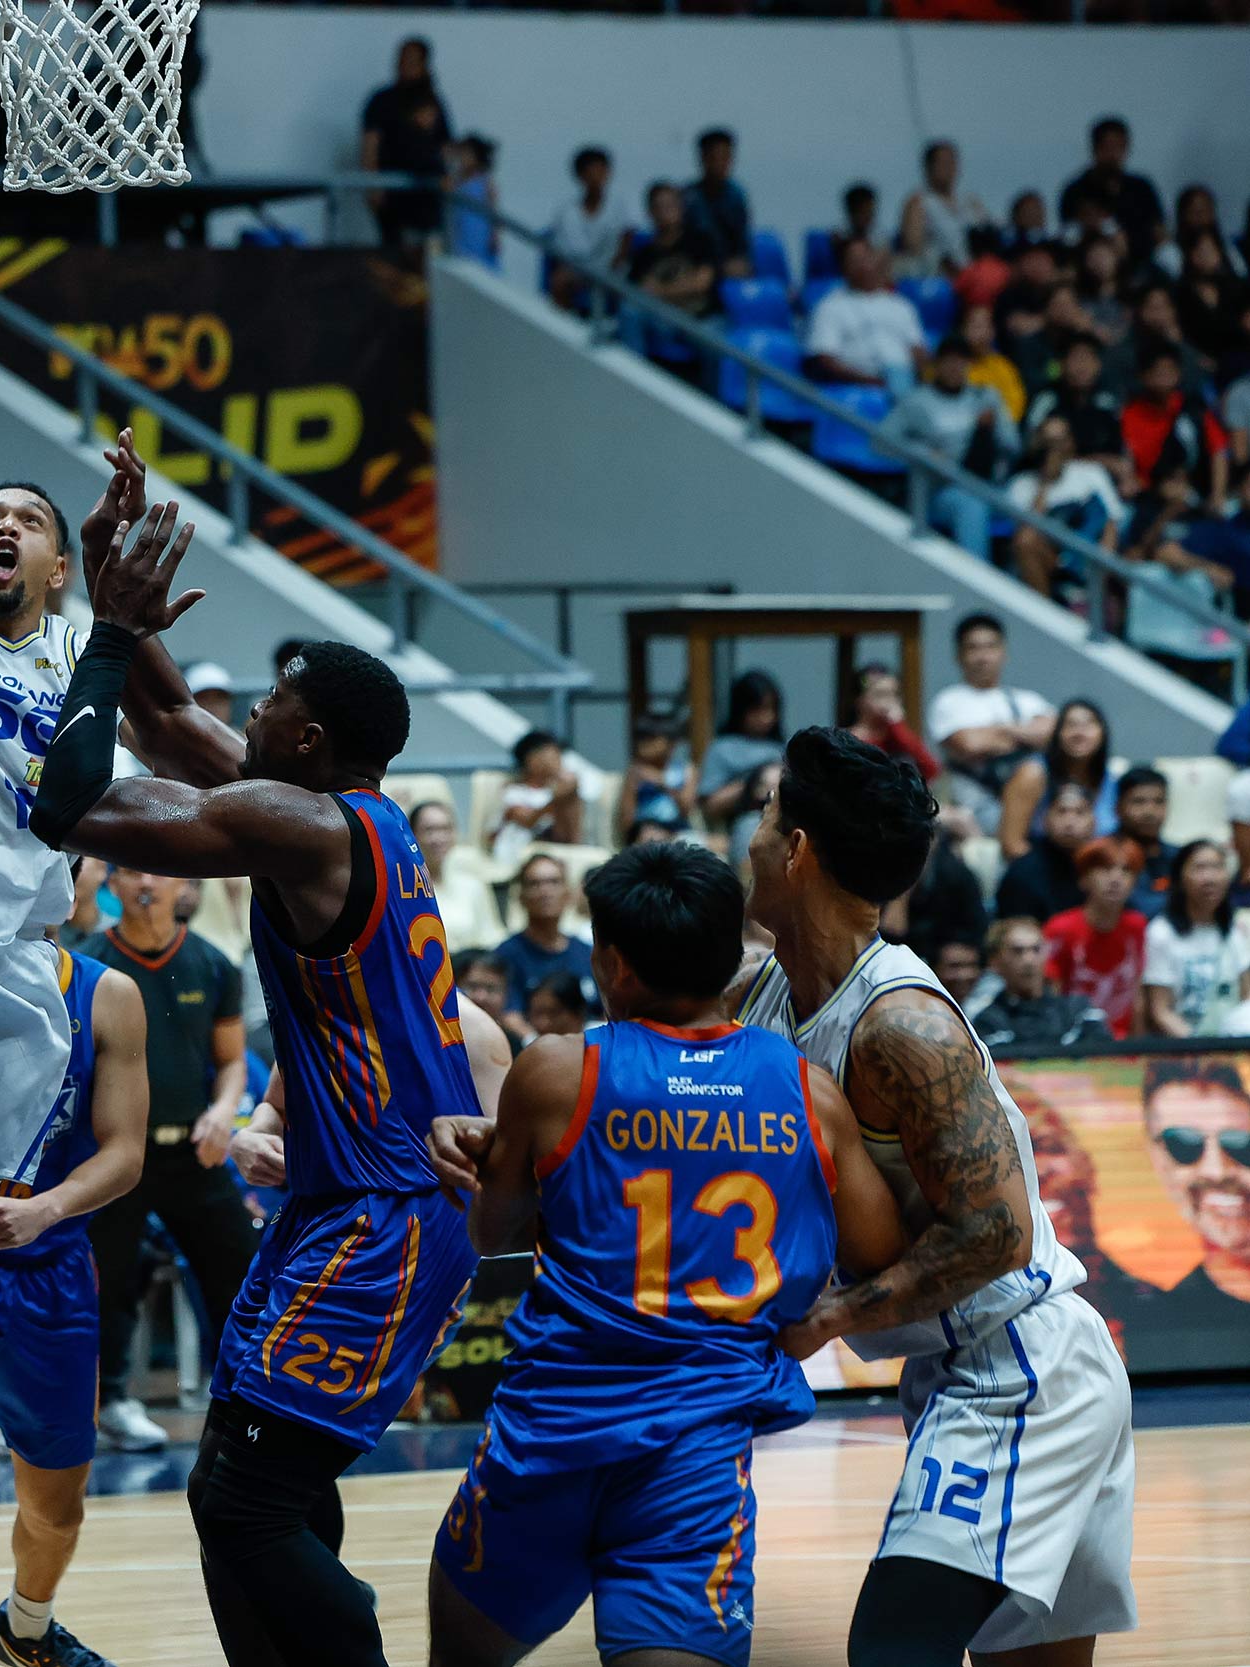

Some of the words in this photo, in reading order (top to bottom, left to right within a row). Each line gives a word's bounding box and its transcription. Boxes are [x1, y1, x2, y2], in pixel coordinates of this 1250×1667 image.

[667, 1084, 744, 1096] CONNECTOR
[606, 1108, 799, 1156] GONZALES
[622, 1168, 783, 1324] 13
[281, 1333, 366, 1395] 25
[919, 1456, 989, 1526] 12
